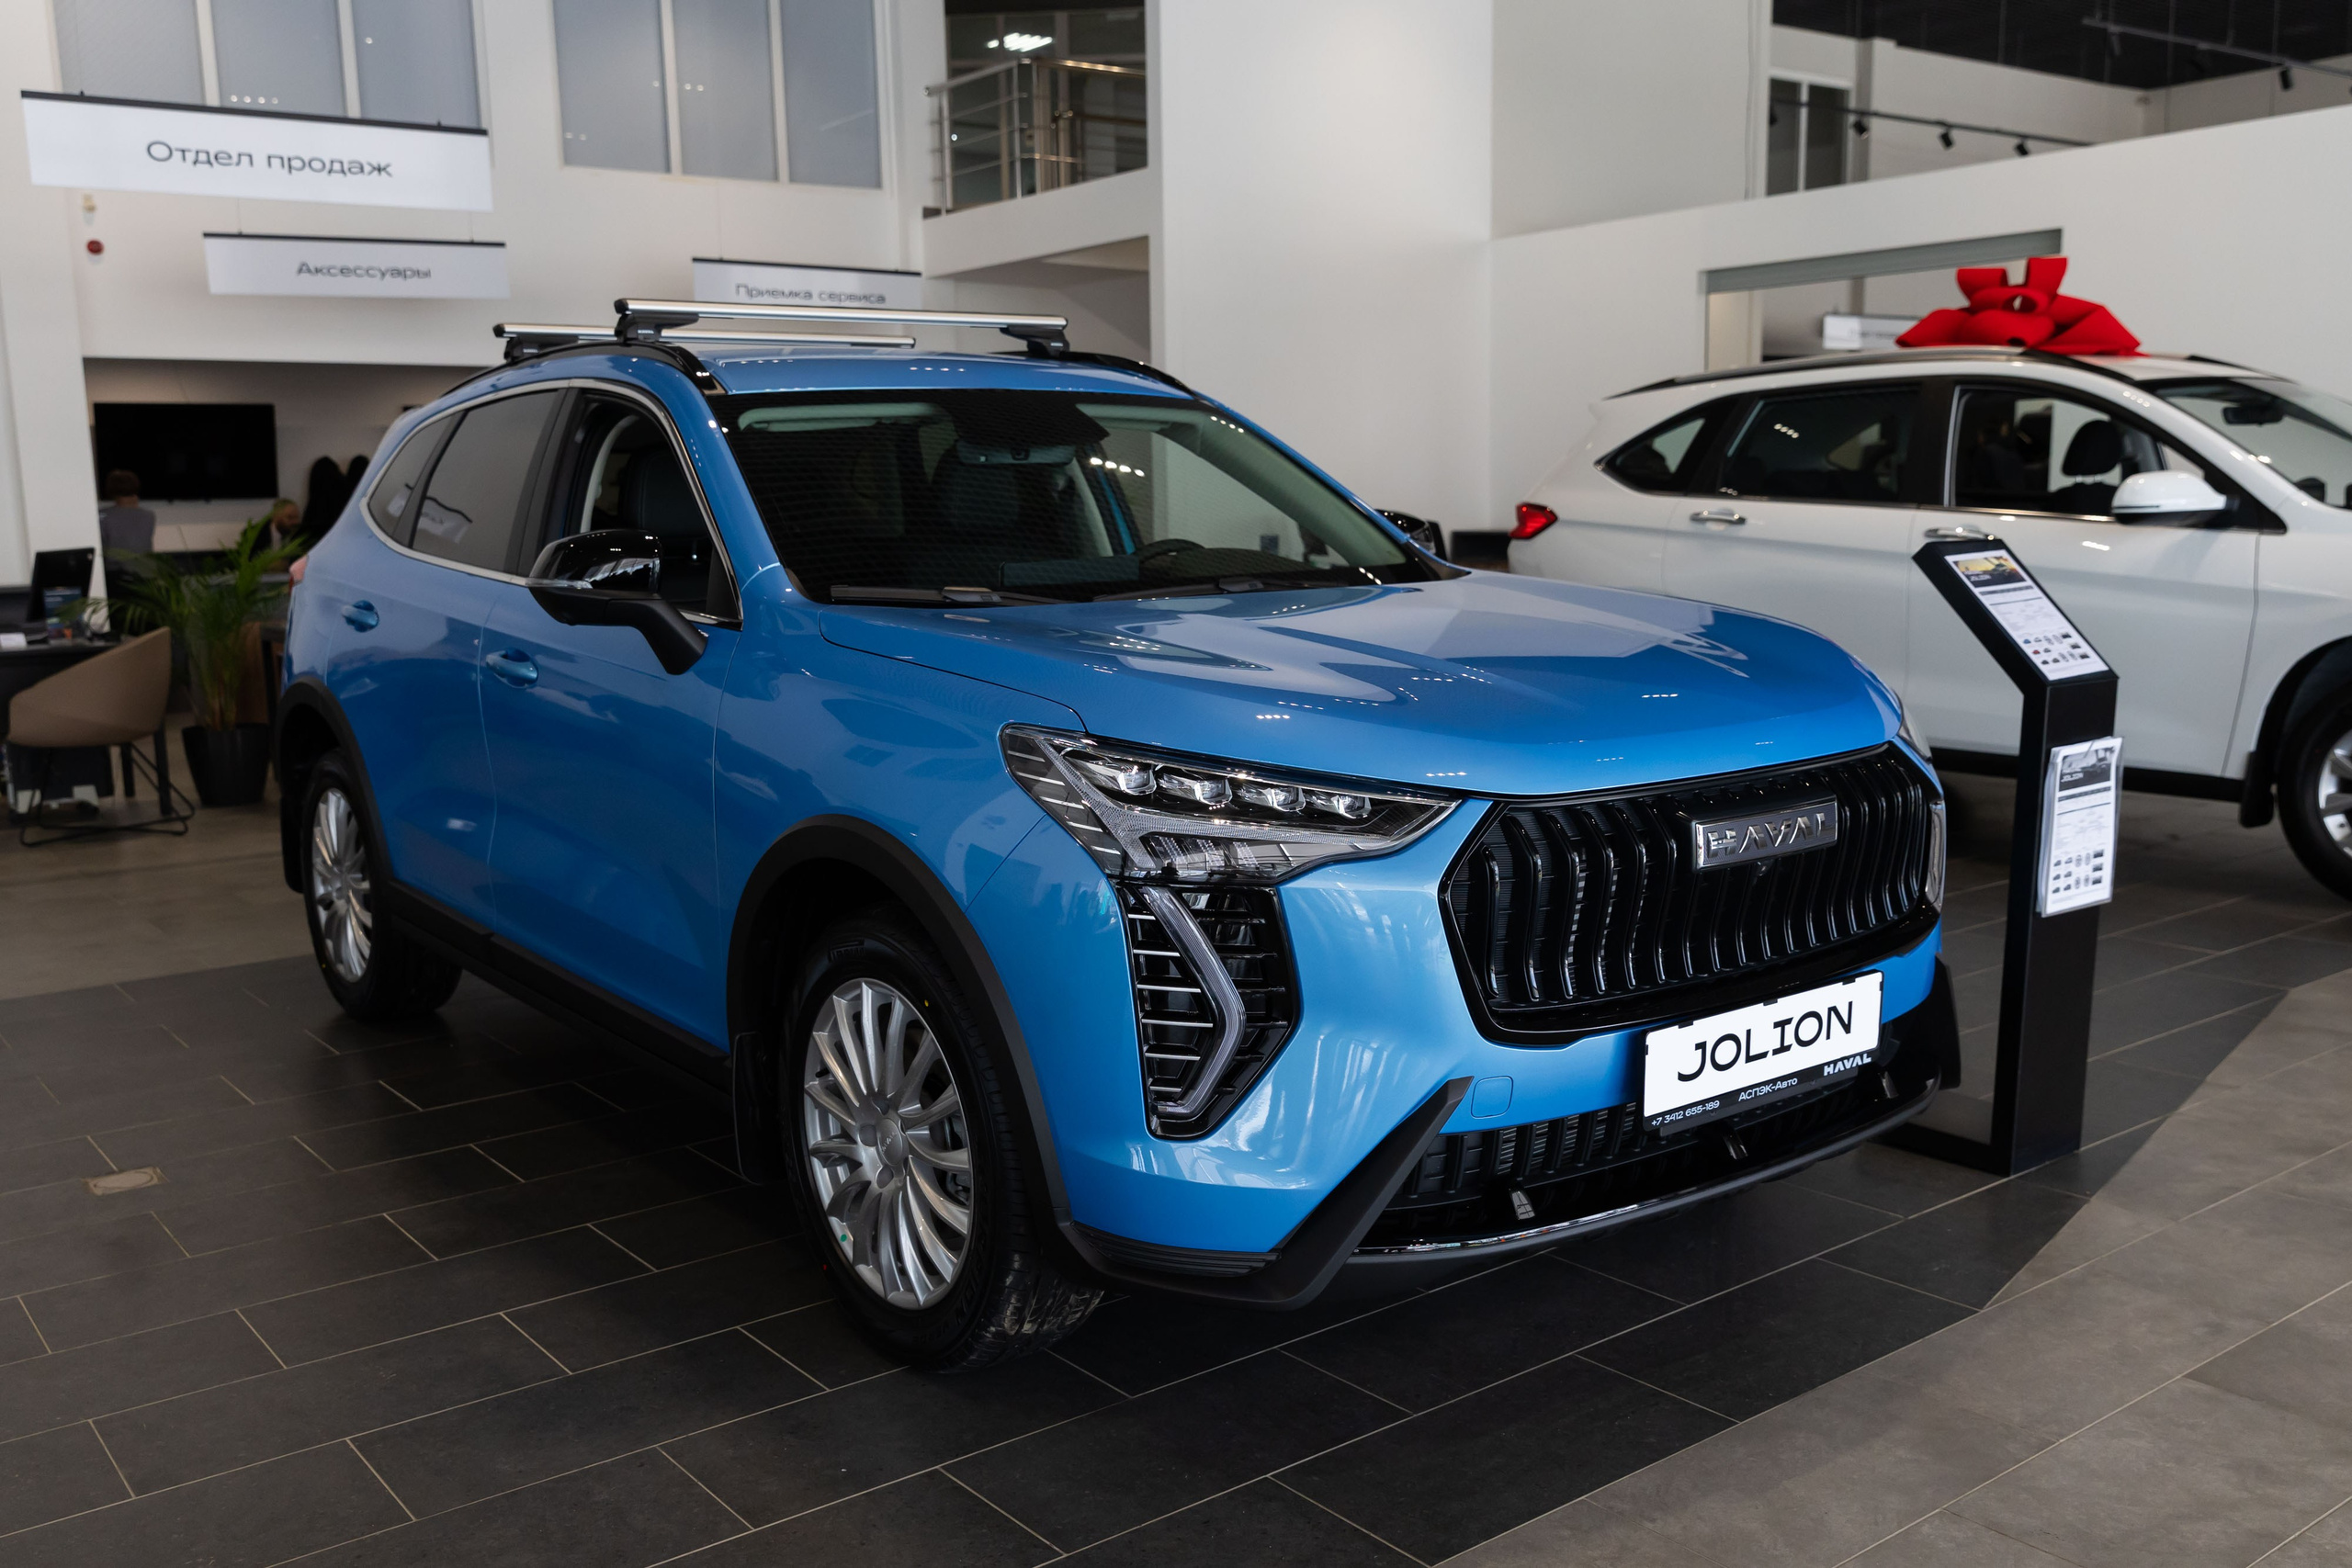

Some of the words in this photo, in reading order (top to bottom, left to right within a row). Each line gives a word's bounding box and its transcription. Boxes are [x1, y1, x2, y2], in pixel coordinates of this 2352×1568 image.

[146, 141, 254, 168] Отдел
[266, 152, 393, 177] продаж
[297, 261, 432, 281] Аксессуары
[735, 283, 813, 300] Приемка
[818, 290, 887, 305] сервиса
[1707, 812, 1834, 858] HAVAL
[1677, 1000, 1853, 1082] JOLION
[1823, 1053, 1872, 1077] HAVAL
[1737, 1077, 1798, 1102] АСПЭК-Авто
[1651, 1116, 1663, 1127] +7
[1663, 1110, 1684, 1123] 3412
[1684, 1100, 1720, 1117] 655-189
